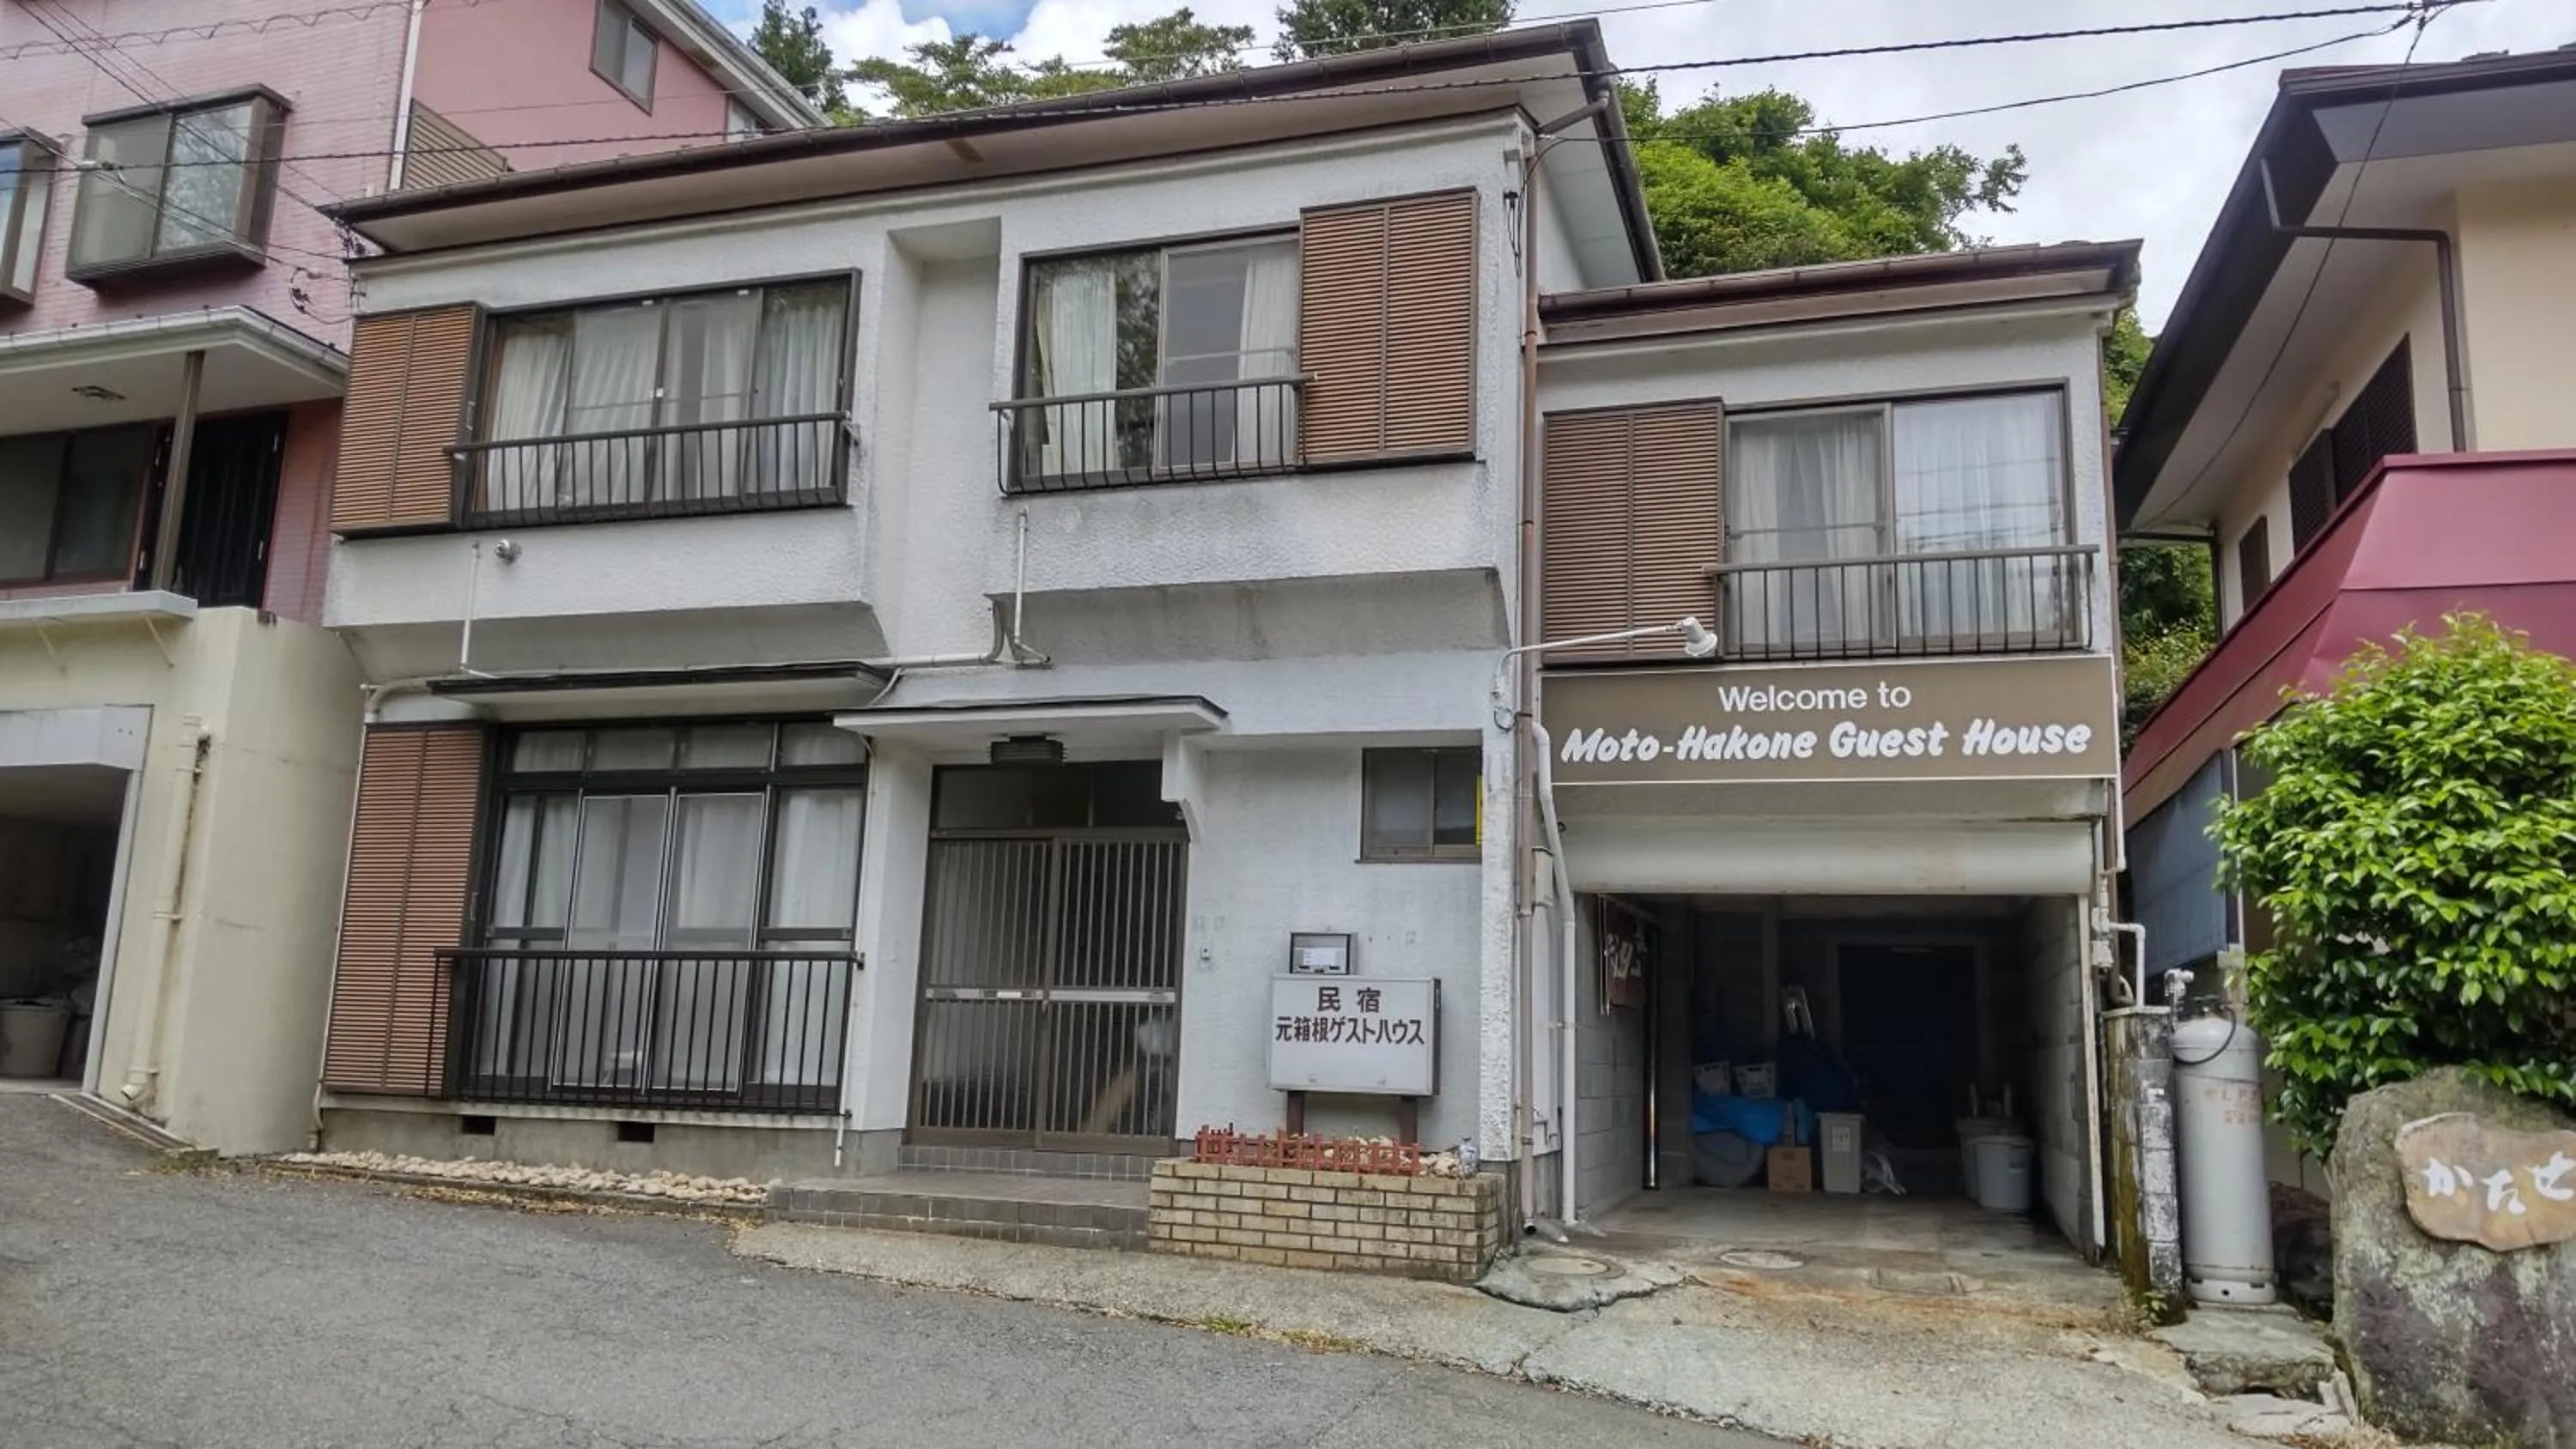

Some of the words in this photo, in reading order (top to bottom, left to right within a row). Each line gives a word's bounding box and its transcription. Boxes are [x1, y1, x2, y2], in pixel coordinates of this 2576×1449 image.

[1718, 685, 1868, 712] Welcome
[1877, 681, 1912, 708] to
[1560, 724, 1818, 762] Moto-Hakone
[1829, 720, 1949, 758] Guest
[1962, 718, 2093, 756] House
[1275, 1016, 1425, 1045] 元箱根ゲストハウス
[2421, 1150, 2576, 1215] かたせ
